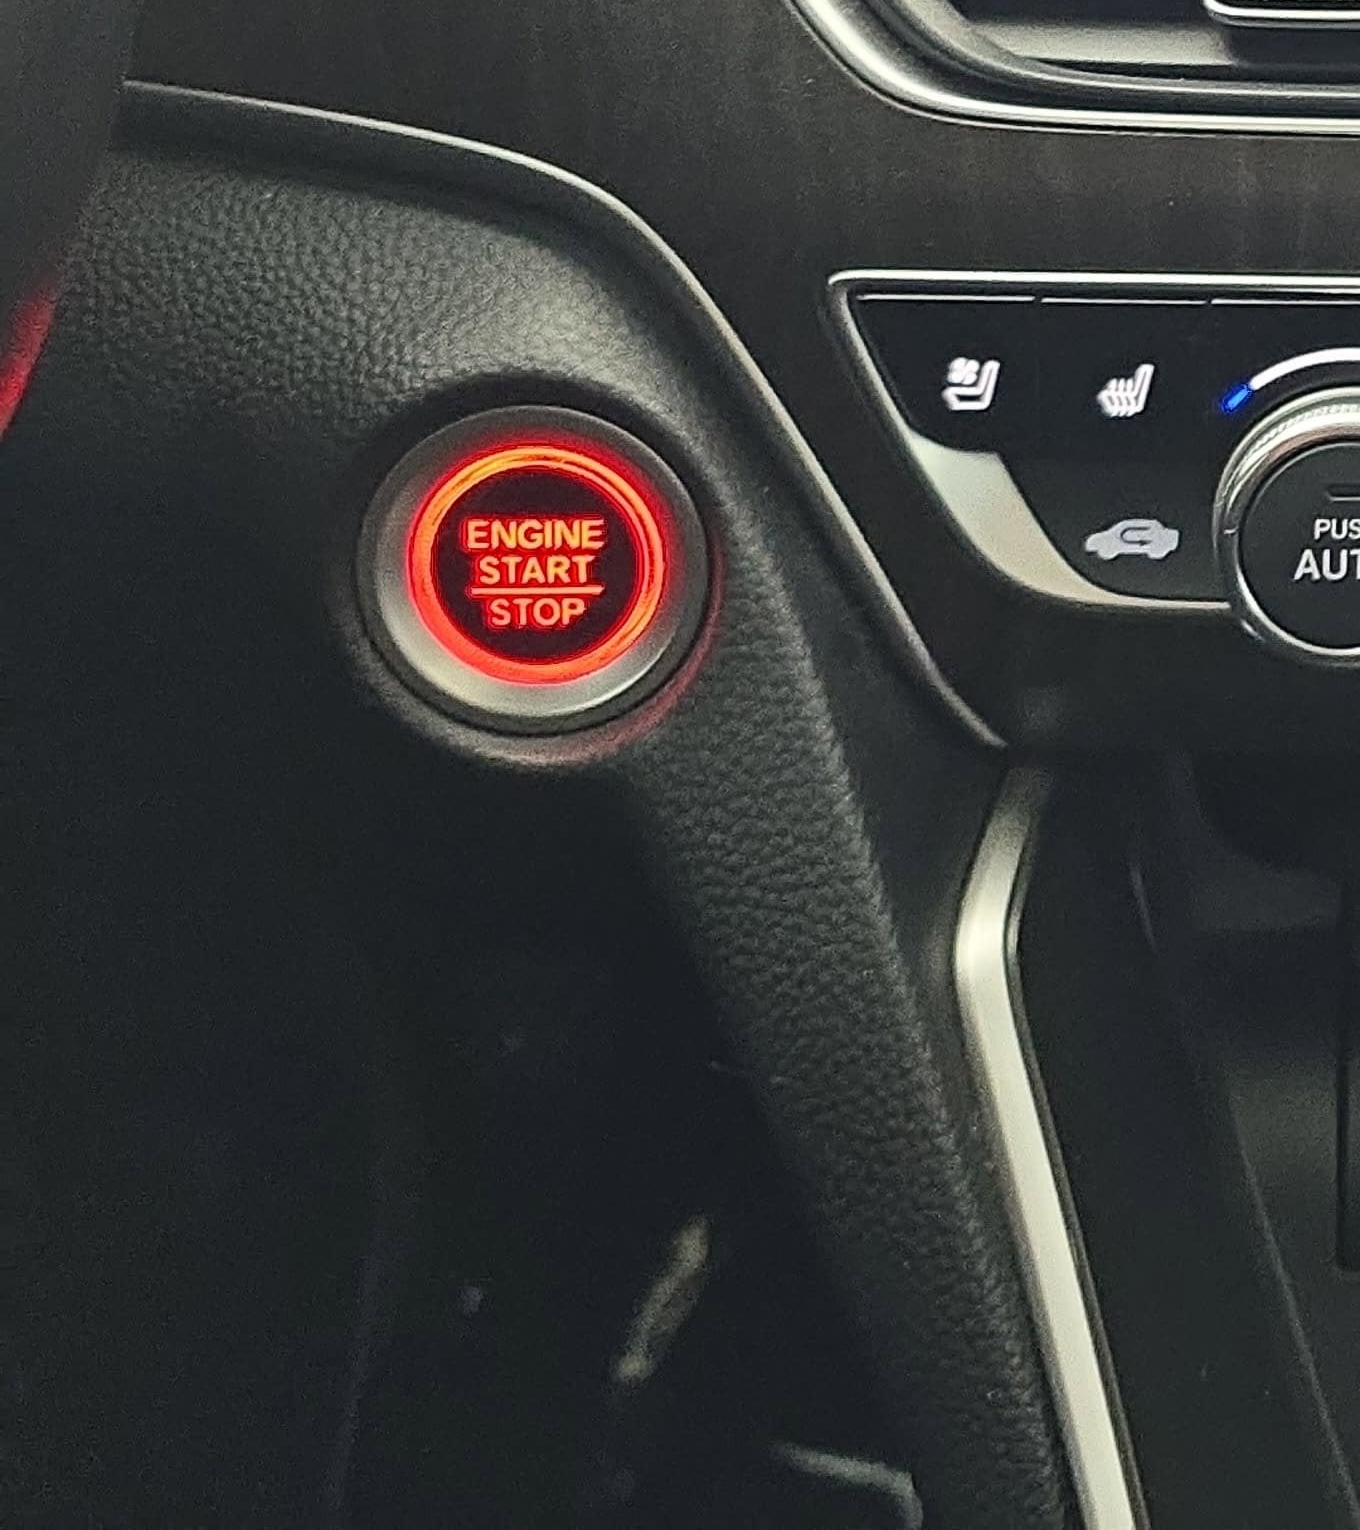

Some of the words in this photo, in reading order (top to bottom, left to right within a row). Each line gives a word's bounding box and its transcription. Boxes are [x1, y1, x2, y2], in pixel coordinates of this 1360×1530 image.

[465, 519, 605, 550] ENGINE
[479, 555, 596, 586] START
[489, 598, 588, 627] STOP
